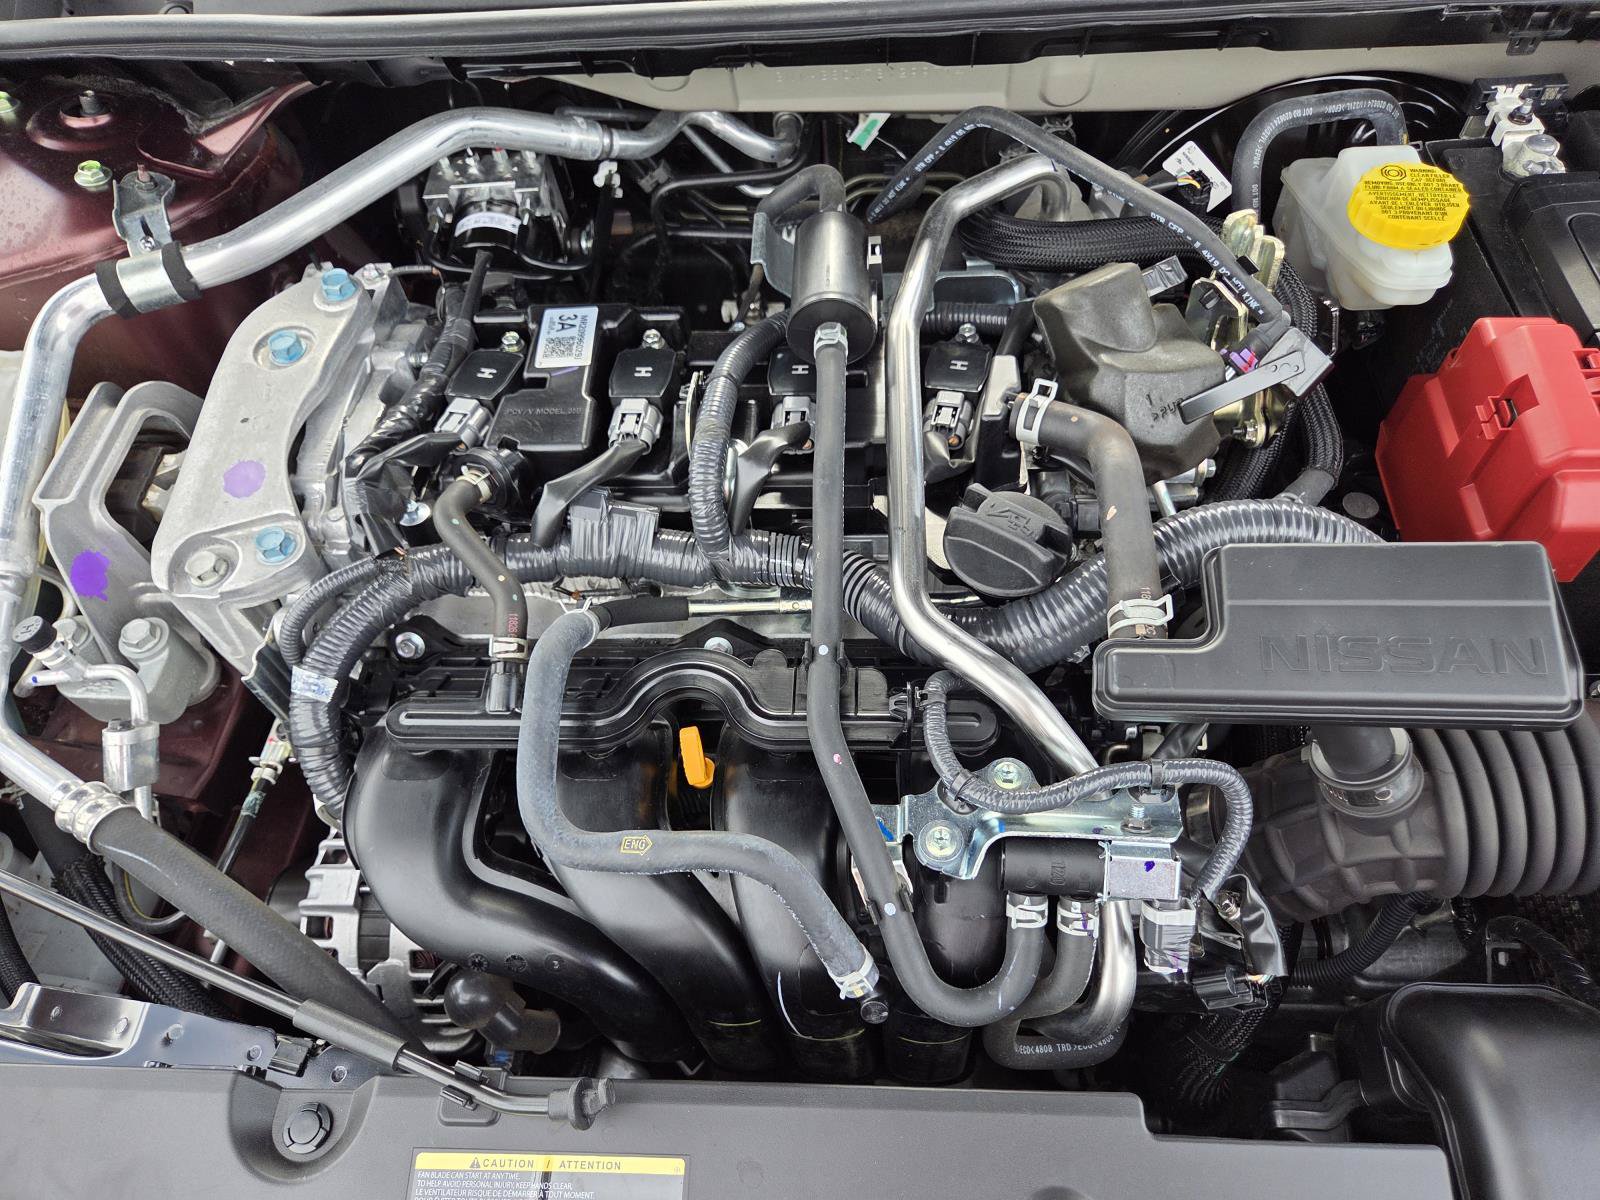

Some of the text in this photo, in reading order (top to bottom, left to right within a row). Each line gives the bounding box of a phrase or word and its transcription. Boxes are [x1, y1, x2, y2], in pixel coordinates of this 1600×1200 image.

[556, 313, 578, 332] 3A
[1260, 634, 1549, 674] NISSAN
[624, 839, 646, 850] ENG
[483, 1158, 534, 1169] CAUTION
[559, 1160, 621, 1170] ATTENTION
[415, 1188, 424, 1196] LE
[424, 1188, 467, 1197] VENTILATEUR
[468, 1189, 491, 1197] RISQUE
[492, 1189, 502, 1197] DE
[546, 1191, 564, 1199] TOUT
